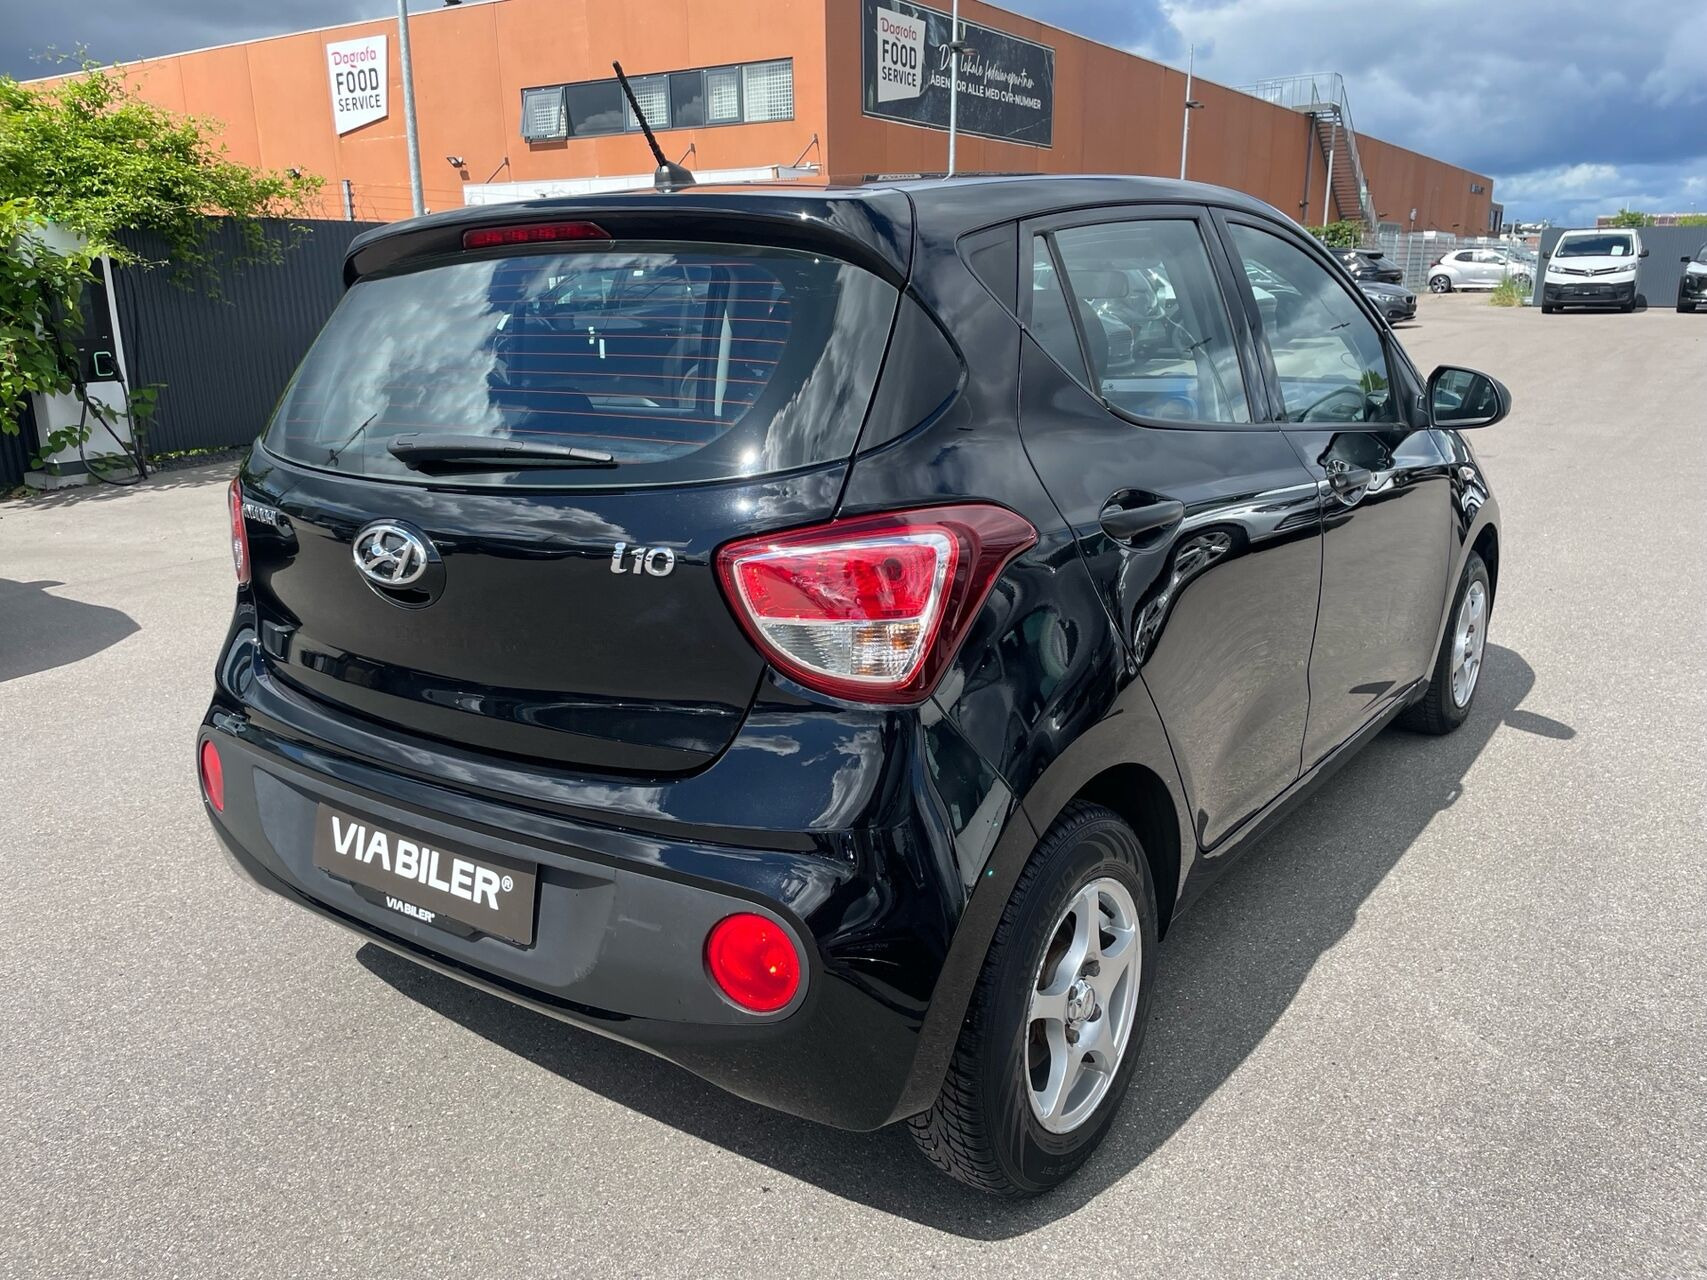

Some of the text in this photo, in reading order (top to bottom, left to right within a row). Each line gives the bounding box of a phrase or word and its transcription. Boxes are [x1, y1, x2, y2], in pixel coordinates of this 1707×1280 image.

[880, 17, 917, 43] Dagrofa
[331, 46, 377, 68] Dagrofa
[882, 40, 917, 70] FOOD
[335, 67, 379, 95] FOOD
[882, 66, 917, 87] SERVICE
[930, 69, 951, 89] ÅBEN
[967, 81, 984, 97] ALLE
[985, 87, 1000, 100] MED
[1000, 90, 1042, 110] CVR-NUMMER
[338, 94, 382, 112] SERVICE
[610, 541, 675, 577] i10
